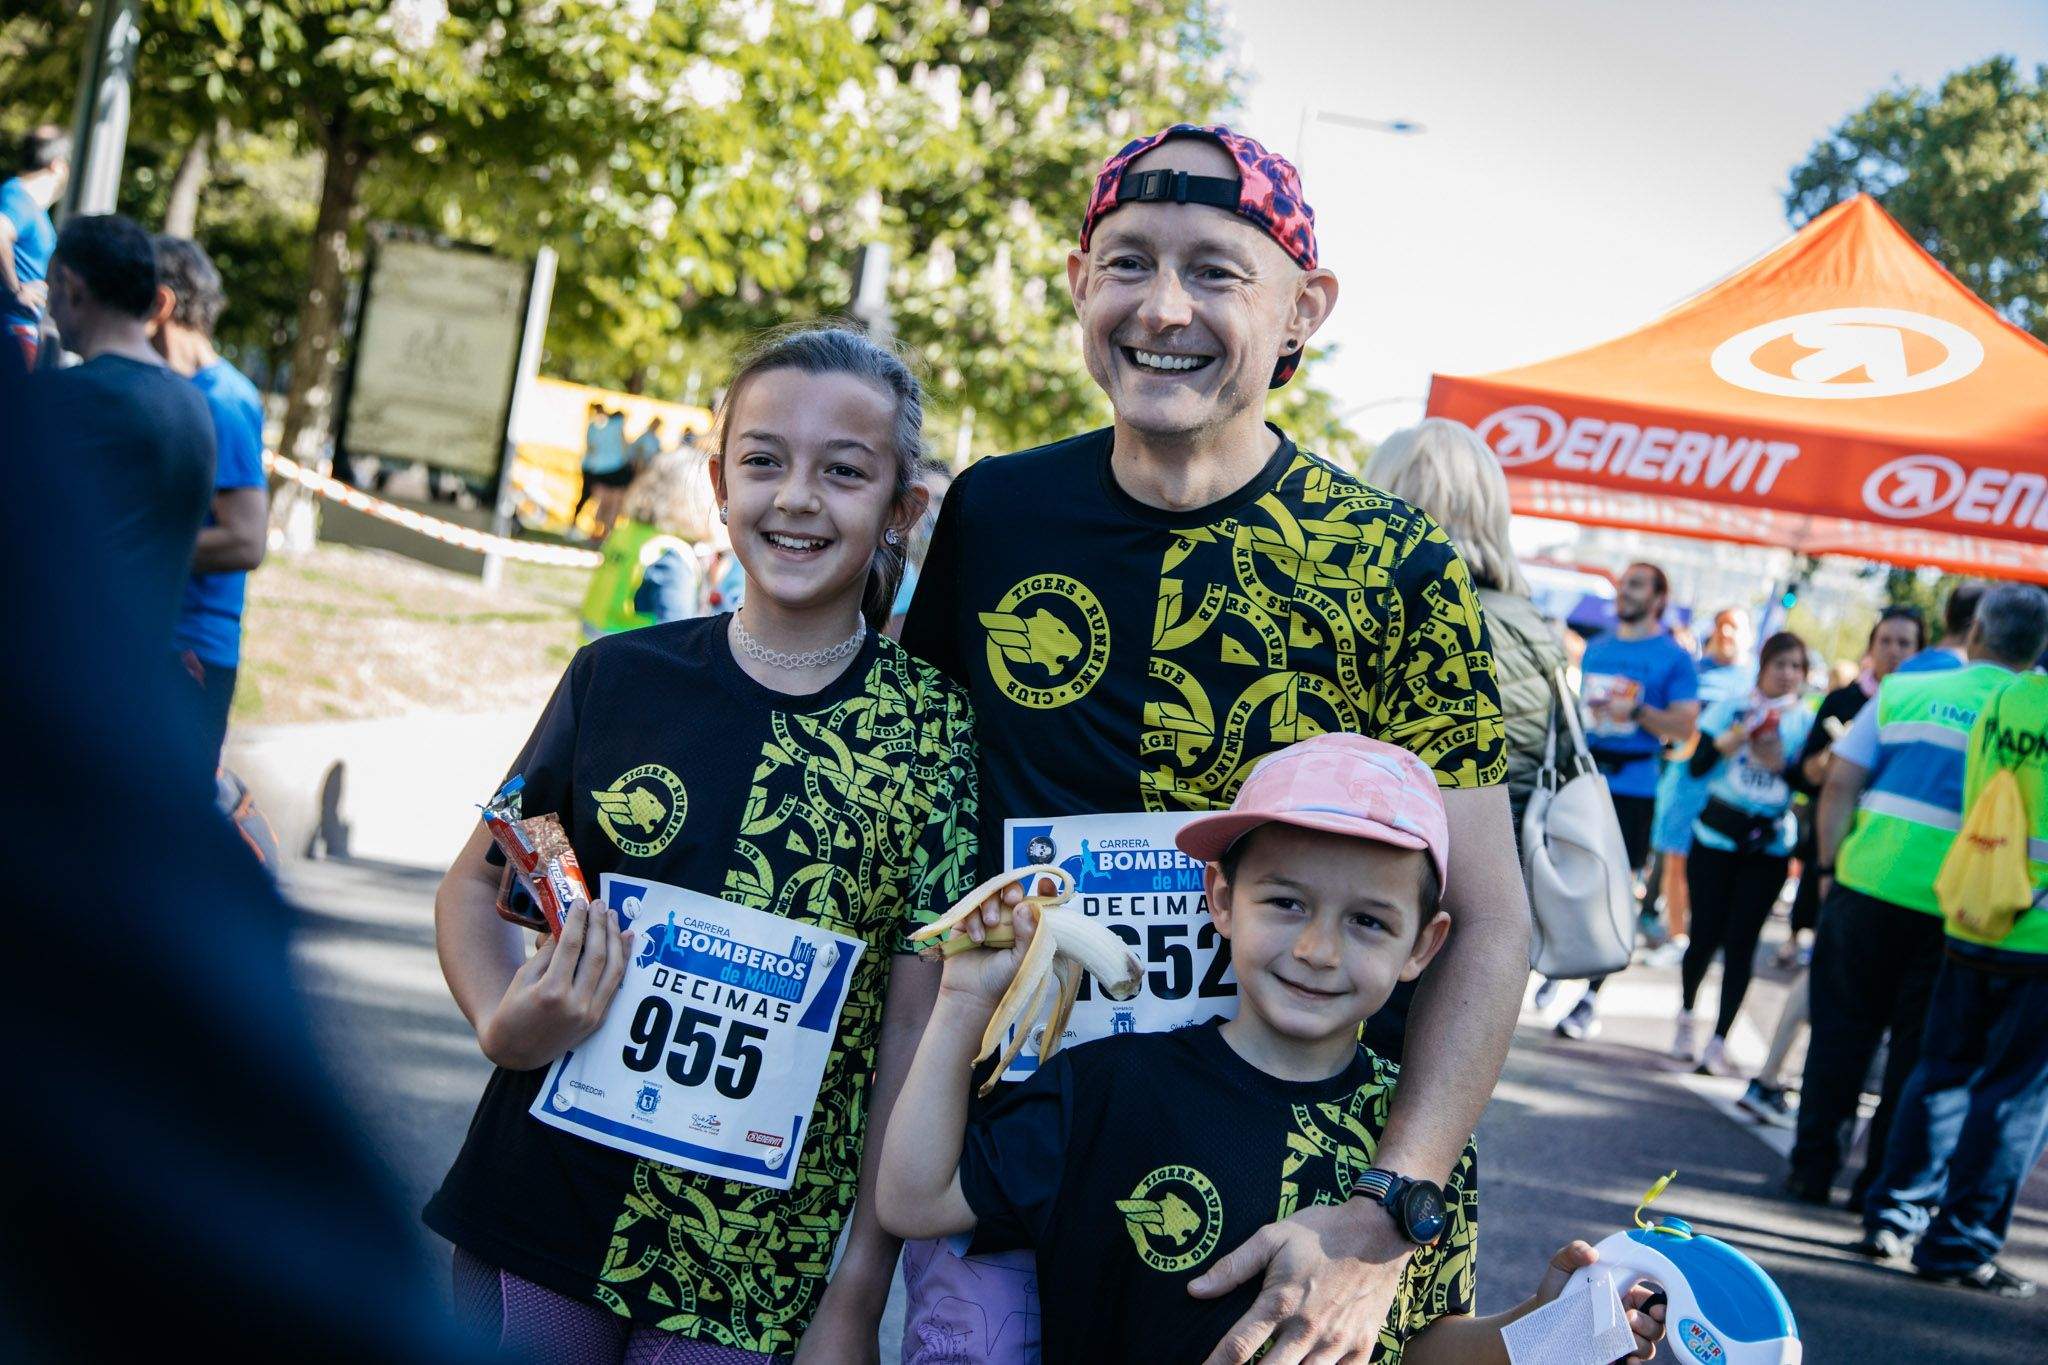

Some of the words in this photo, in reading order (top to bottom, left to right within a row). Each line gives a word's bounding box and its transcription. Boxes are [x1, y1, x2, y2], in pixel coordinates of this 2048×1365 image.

[1553, 417, 1800, 495] ENERVIT
[1012, 577, 1077, 600] TIGERS
[1071, 604, 1107, 694] RUNNING
[1007, 680, 1053, 705] CLUB
[621, 766, 668, 783] TIGERS
[659, 785, 685, 847] RUNNING
[616, 837, 650, 855] CLUB
[1099, 839, 1151, 849] CARRERA
[1099, 851, 1206, 871] BOMBER
[1153, 871, 1173, 889] de
[1176, 870, 1202, 889] MA
[1083, 895, 1211, 917] DECIMA
[684, 917, 731, 937] CARRERA
[677, 930, 806, 980] BOMBEROS
[720, 963, 741, 984] de
[744, 970, 801, 1000] MADRID
[652, 968, 791, 1023] DECIMAS
[622, 995, 769, 1099] 955
[1142, 1168, 1195, 1188] TIGERS
[1191, 1186, 1220, 1261] RUNNING
[1145, 1249, 1178, 1269] CLUB
[1688, 1339, 1712, 1361] GUN
[1691, 1324, 1721, 1357] WATER
